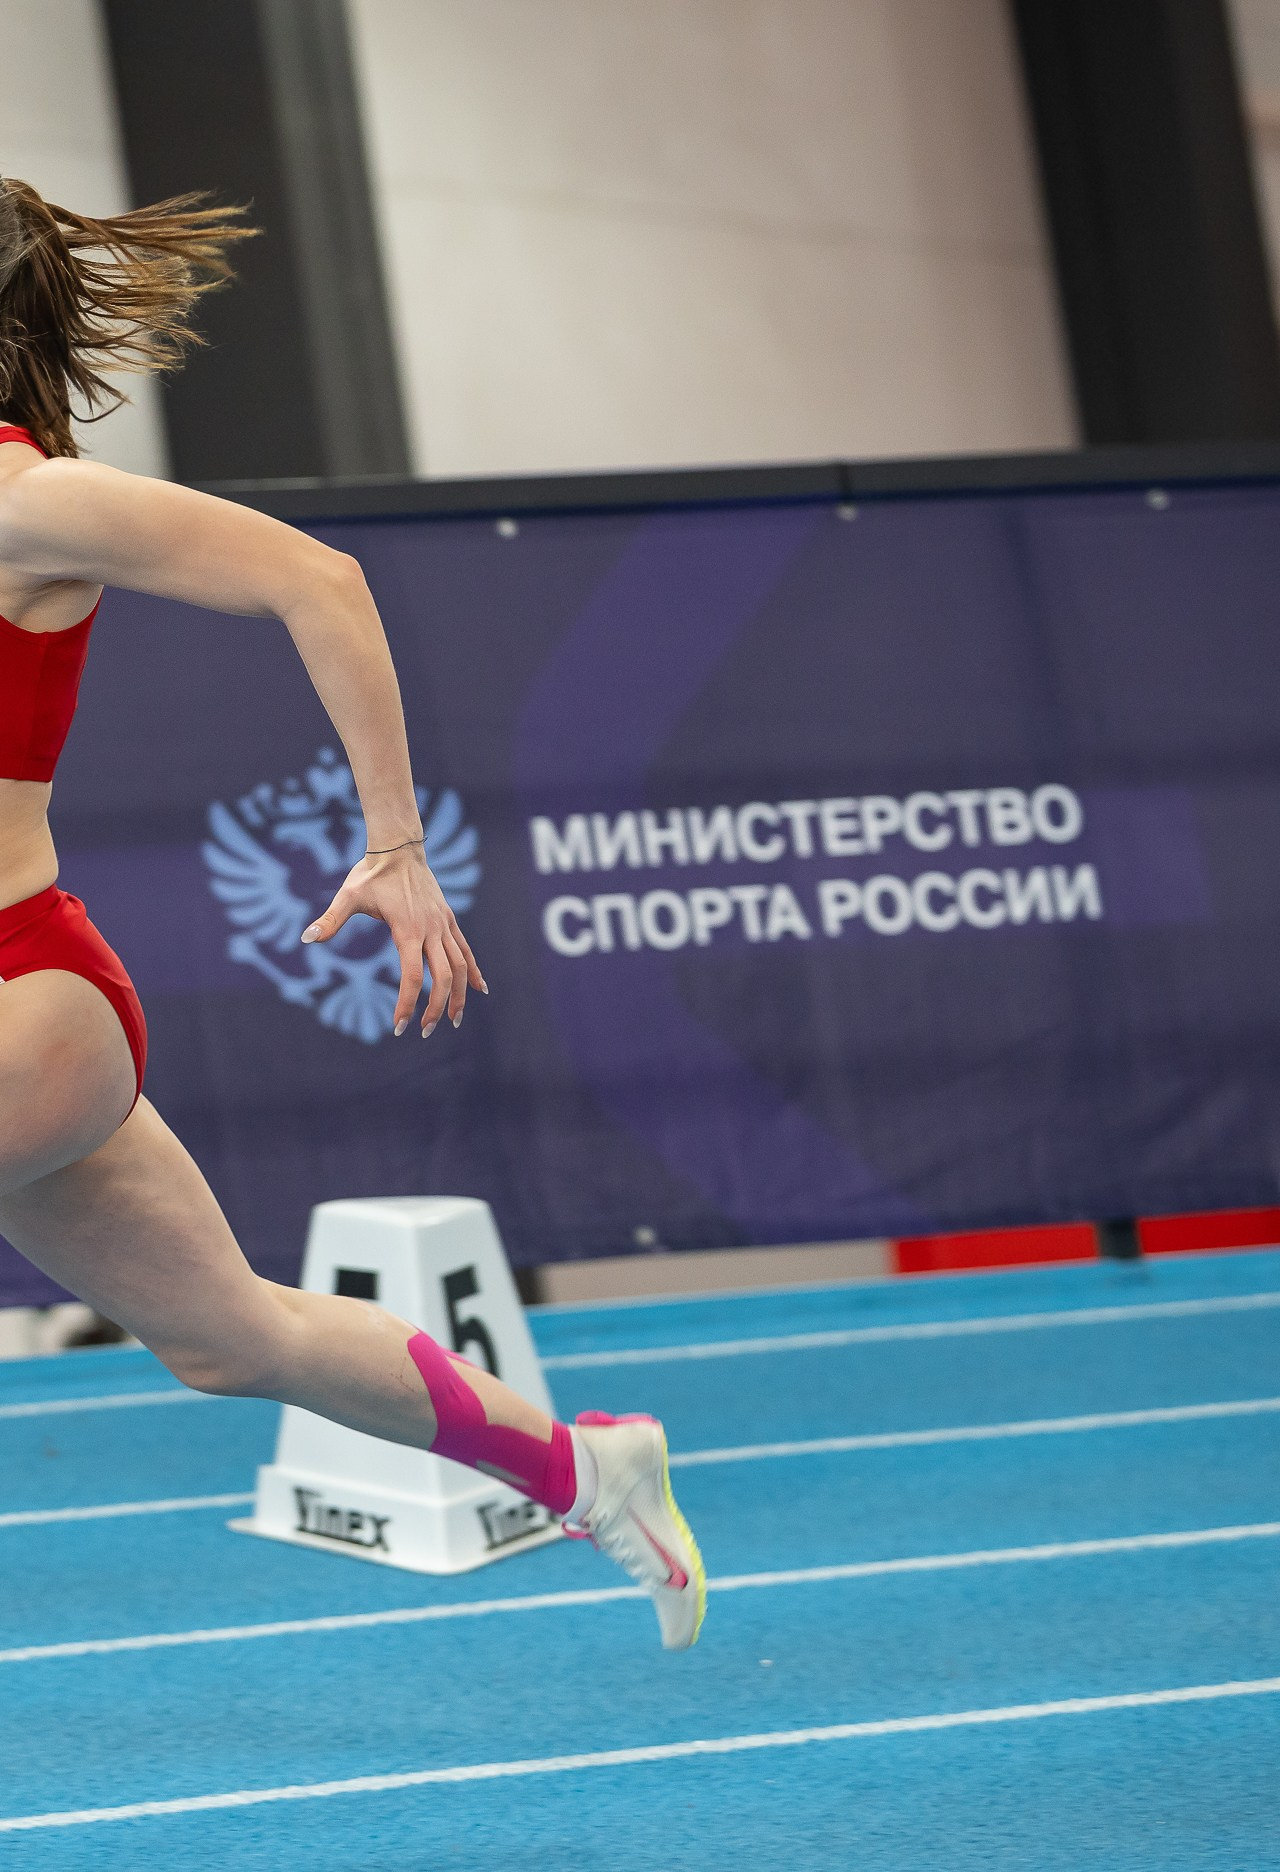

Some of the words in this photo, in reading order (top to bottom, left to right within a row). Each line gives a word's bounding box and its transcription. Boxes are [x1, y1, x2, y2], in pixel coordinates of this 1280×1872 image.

[529, 783, 1085, 875] МИНИСТЕРСТВО
[542, 885, 813, 958] СПОРТА
[818, 862, 1103, 939] РОССИИ
[441, 1262, 505, 1382] 5
